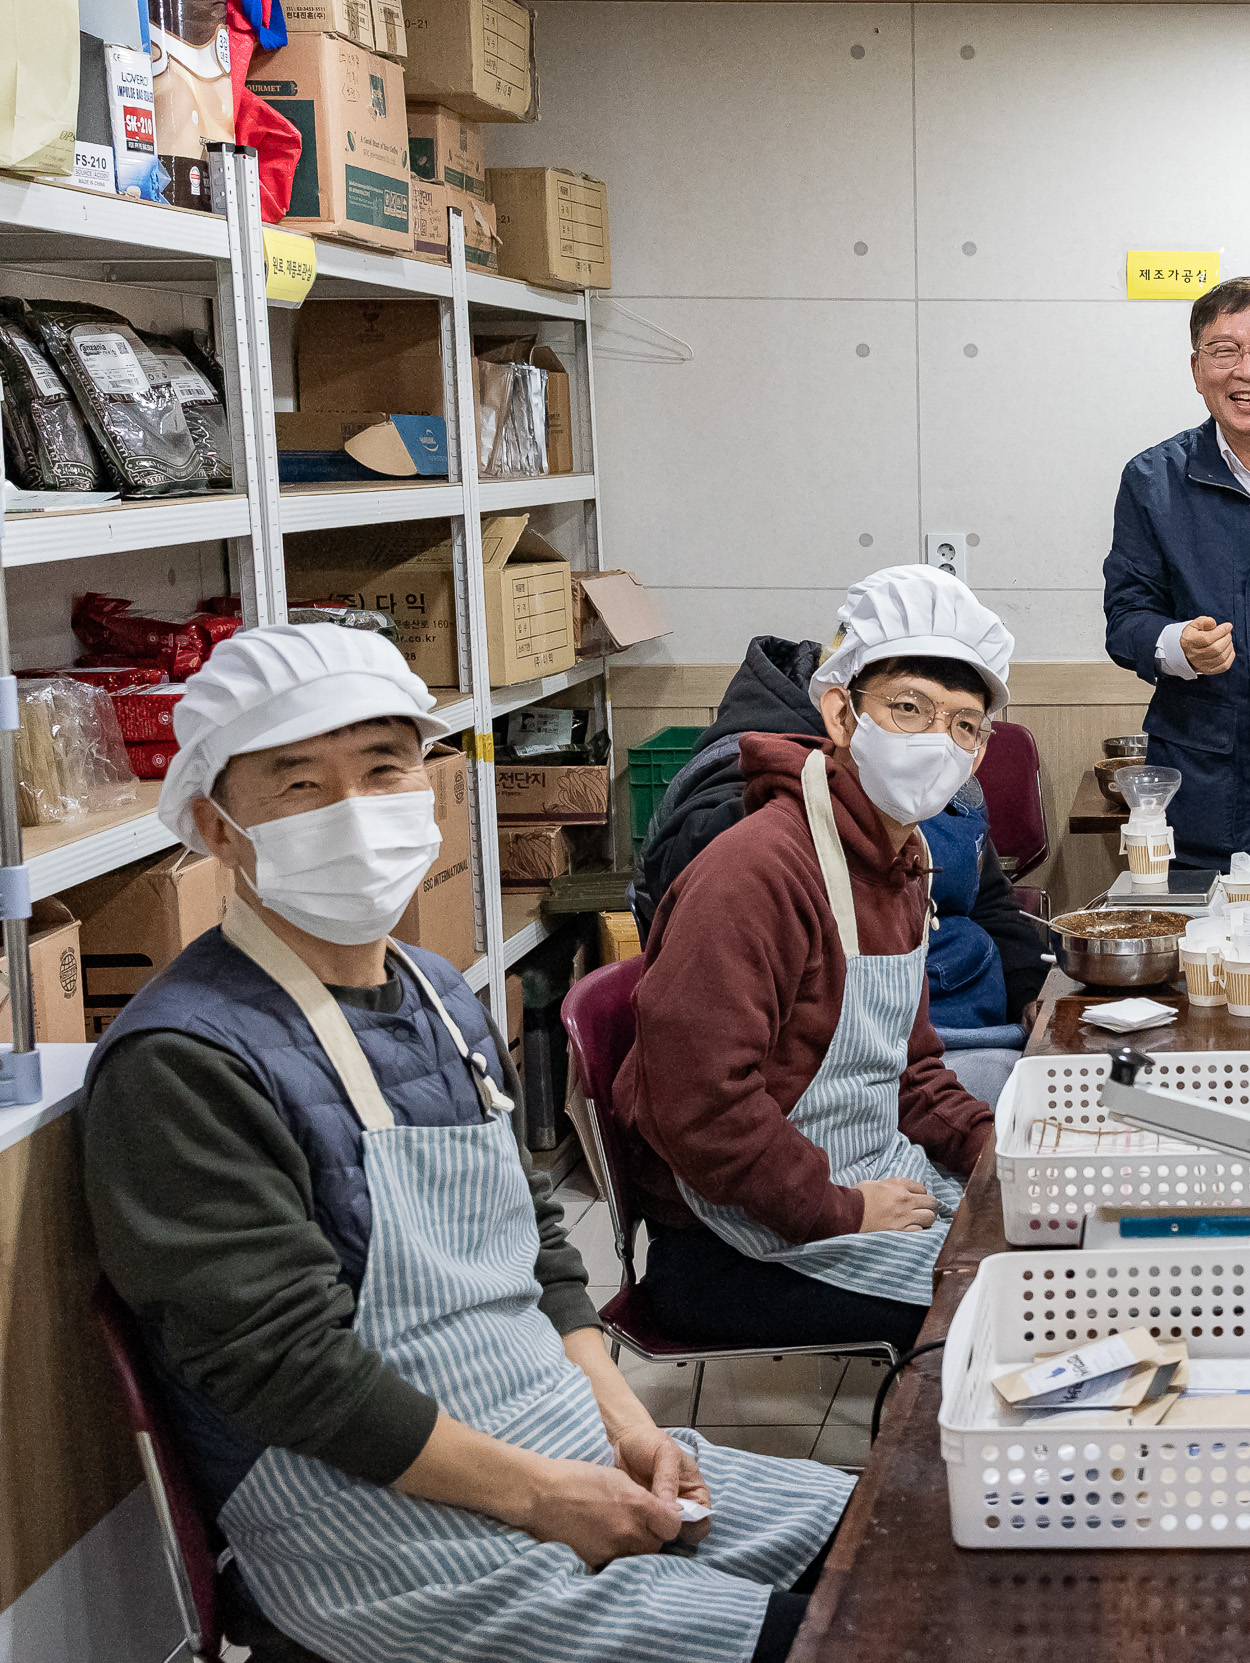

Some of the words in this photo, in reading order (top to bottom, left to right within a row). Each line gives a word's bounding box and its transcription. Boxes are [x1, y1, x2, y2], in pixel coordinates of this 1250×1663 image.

[404, 20, 428, 29] 0-21
[246, 84, 282, 92] OURMET
[75, 153, 107, 170] FS-210
[396, 634, 437, 643] r.co.kr
[404, 652, 417, 661] 28
